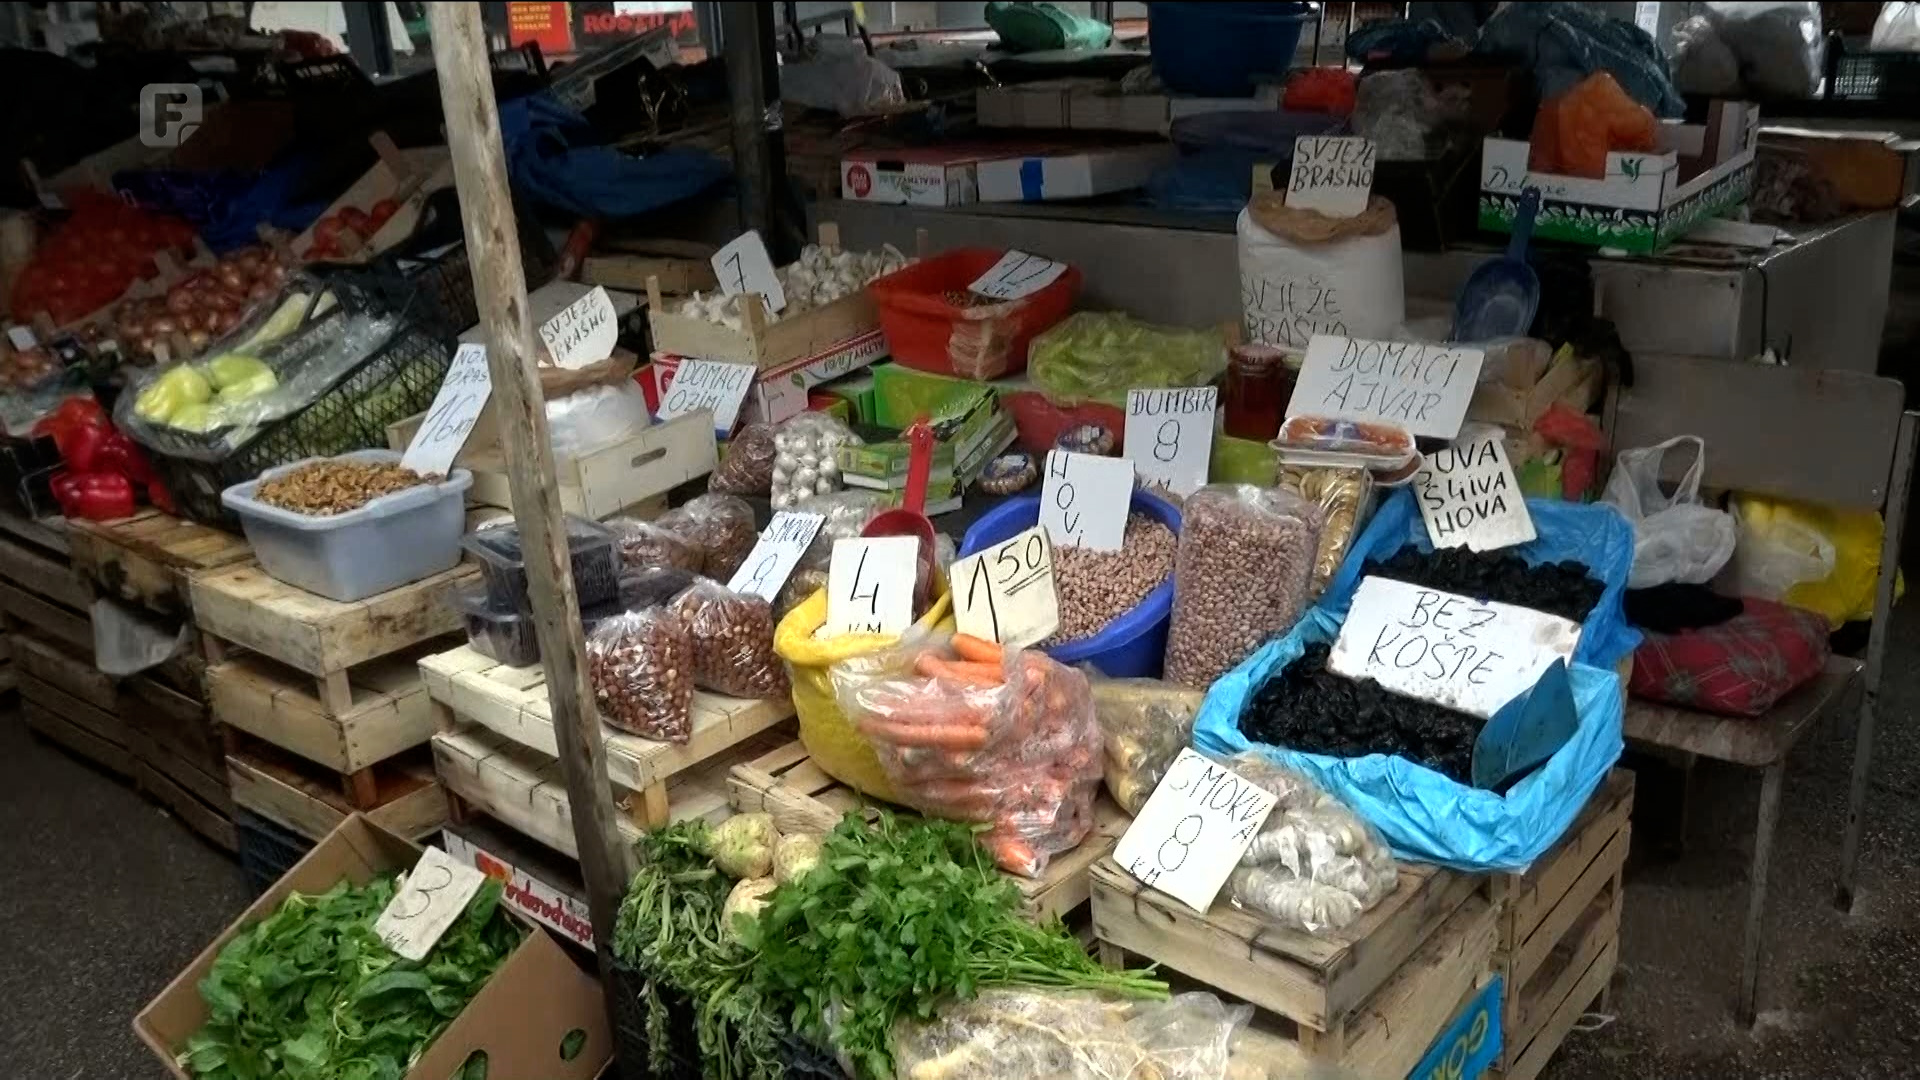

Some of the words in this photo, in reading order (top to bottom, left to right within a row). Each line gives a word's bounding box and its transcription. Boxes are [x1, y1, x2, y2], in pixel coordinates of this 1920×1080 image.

[1484, 166, 1567, 196] Delxe
[724, 251, 747, 294] 7
[1323, 372, 1442, 421] AJVAR
[1153, 419, 1181, 462] 8
[850, 545, 880, 615] 4
[1397, 590, 1498, 638] BEZ
[1157, 813, 1204, 873] 8
[391, 864, 453, 920] 3
[1129, 856, 1162, 886] KM
